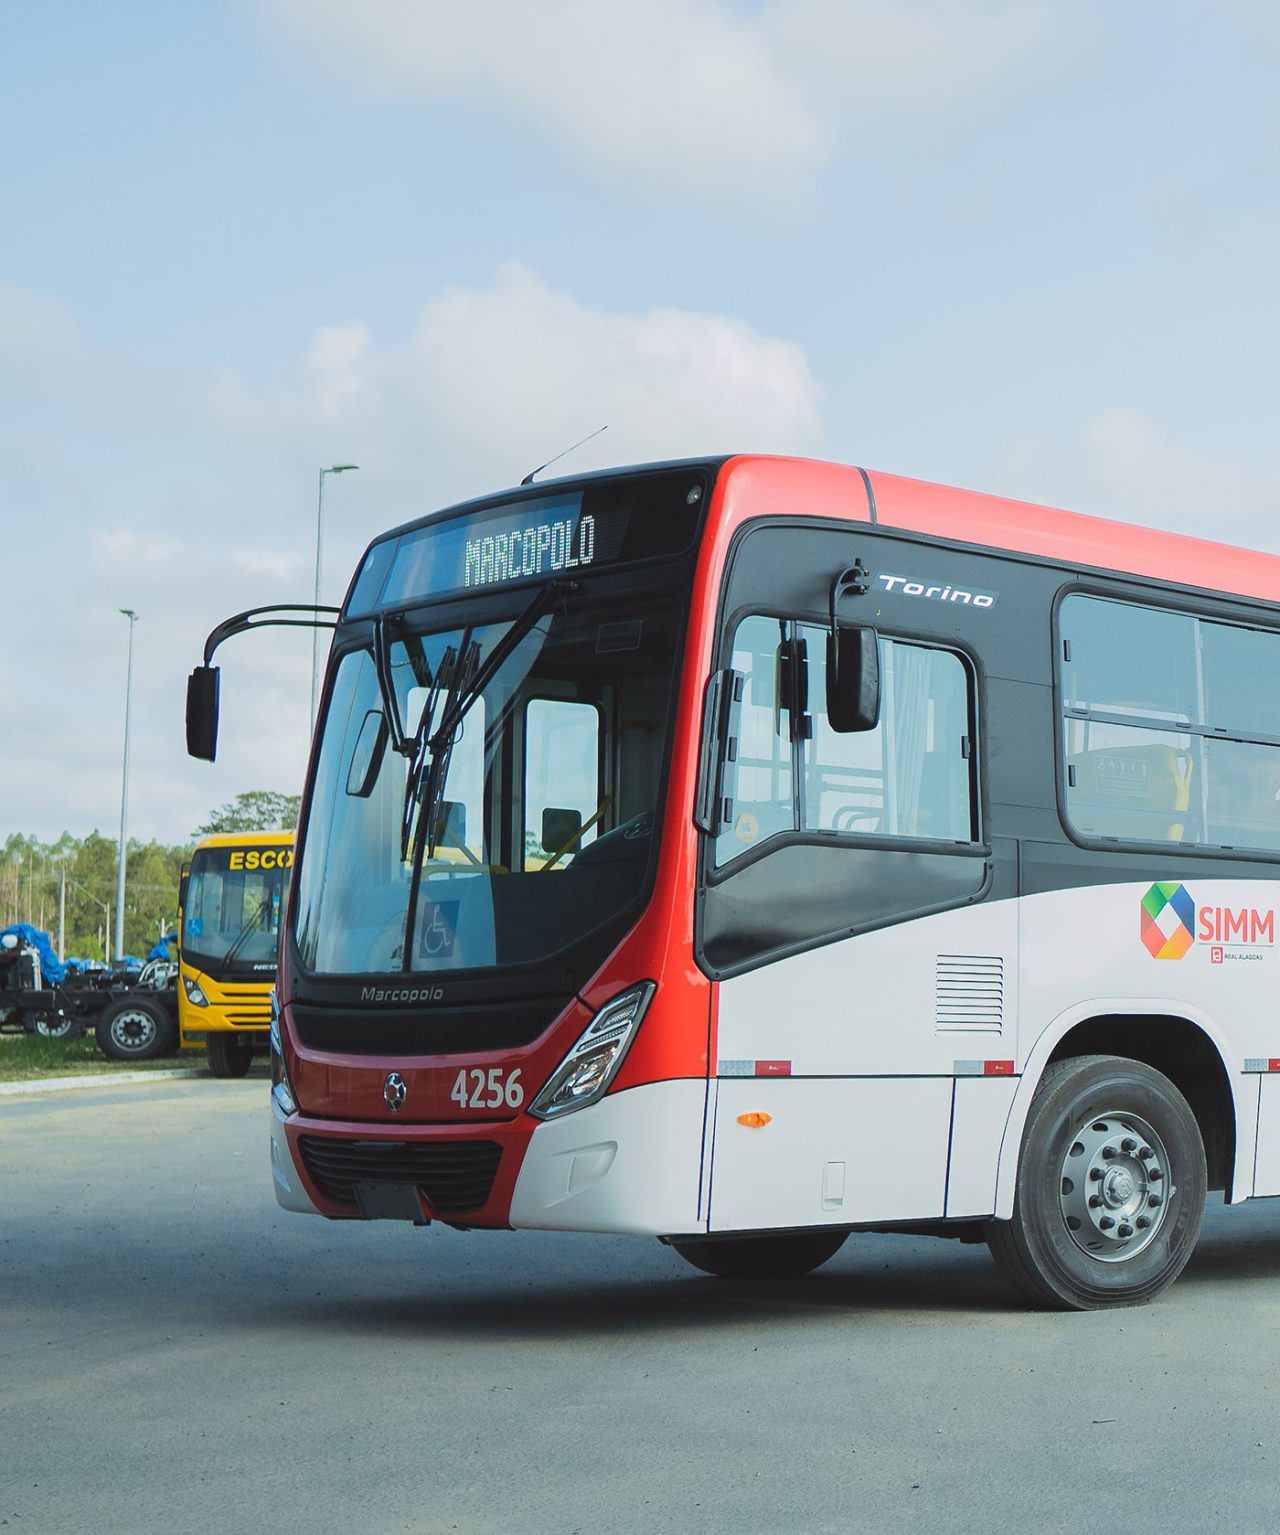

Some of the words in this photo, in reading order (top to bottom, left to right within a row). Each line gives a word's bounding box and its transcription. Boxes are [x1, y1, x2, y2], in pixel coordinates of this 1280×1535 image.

[464, 515, 595, 587] MARCOPOLO
[879, 574, 994, 607] Torino
[1198, 906, 1274, 943] SIMM
[360, 985, 444, 1004] Marcopolo
[450, 1067, 524, 1108] 4256
